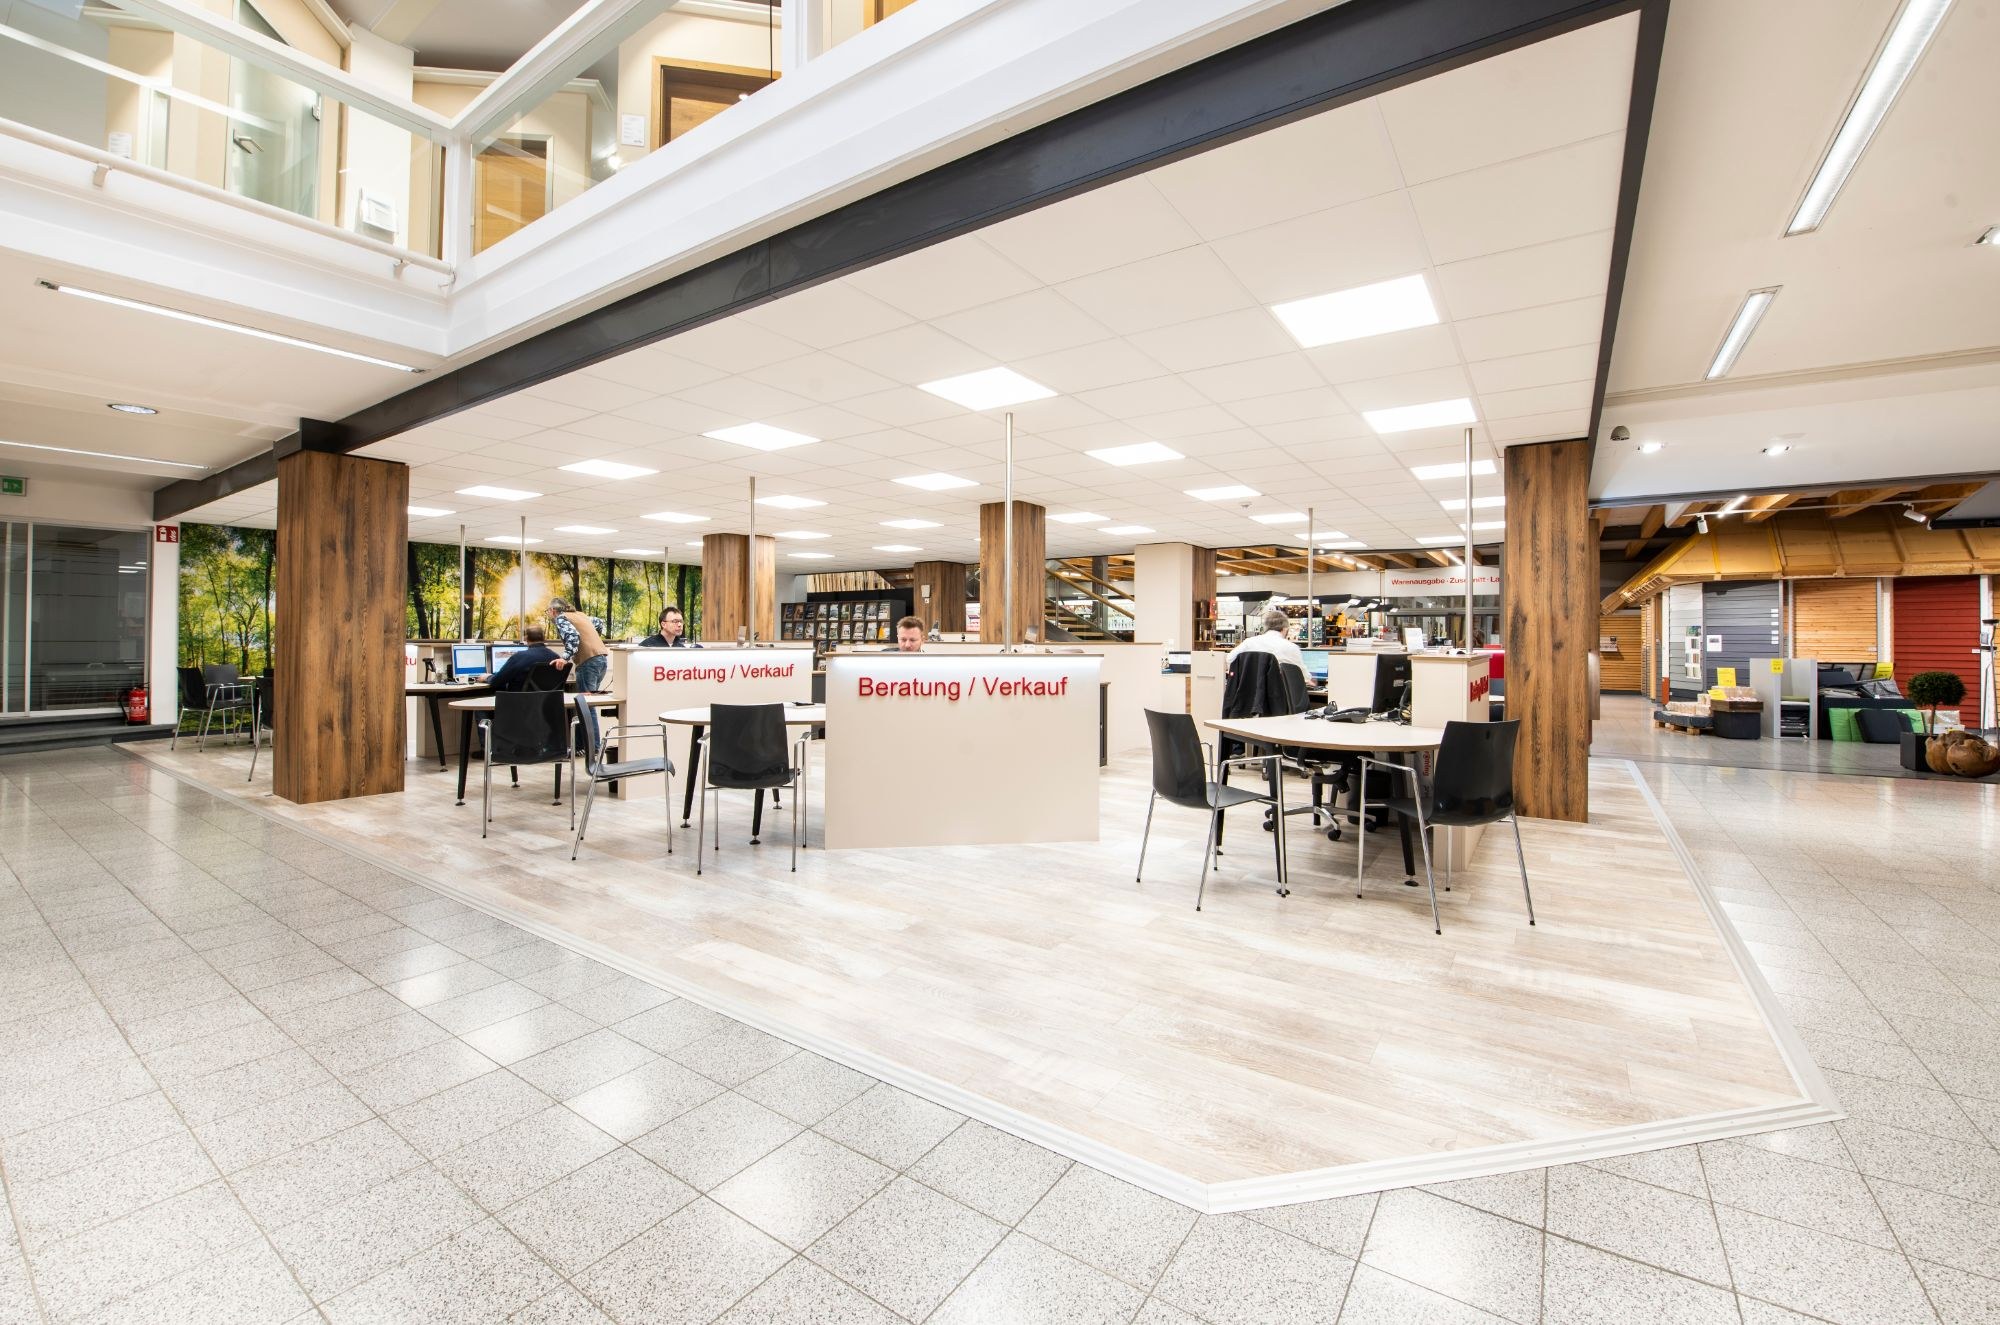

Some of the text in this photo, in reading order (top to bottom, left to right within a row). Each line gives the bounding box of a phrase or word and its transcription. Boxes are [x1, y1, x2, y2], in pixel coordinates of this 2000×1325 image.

[1391, 578, 1446, 586] Warenausgabe
[653, 665, 726, 683] Beratung
[740, 663, 795, 679] Verkauf
[858, 676, 1069, 701] Beratung / Verkauf
